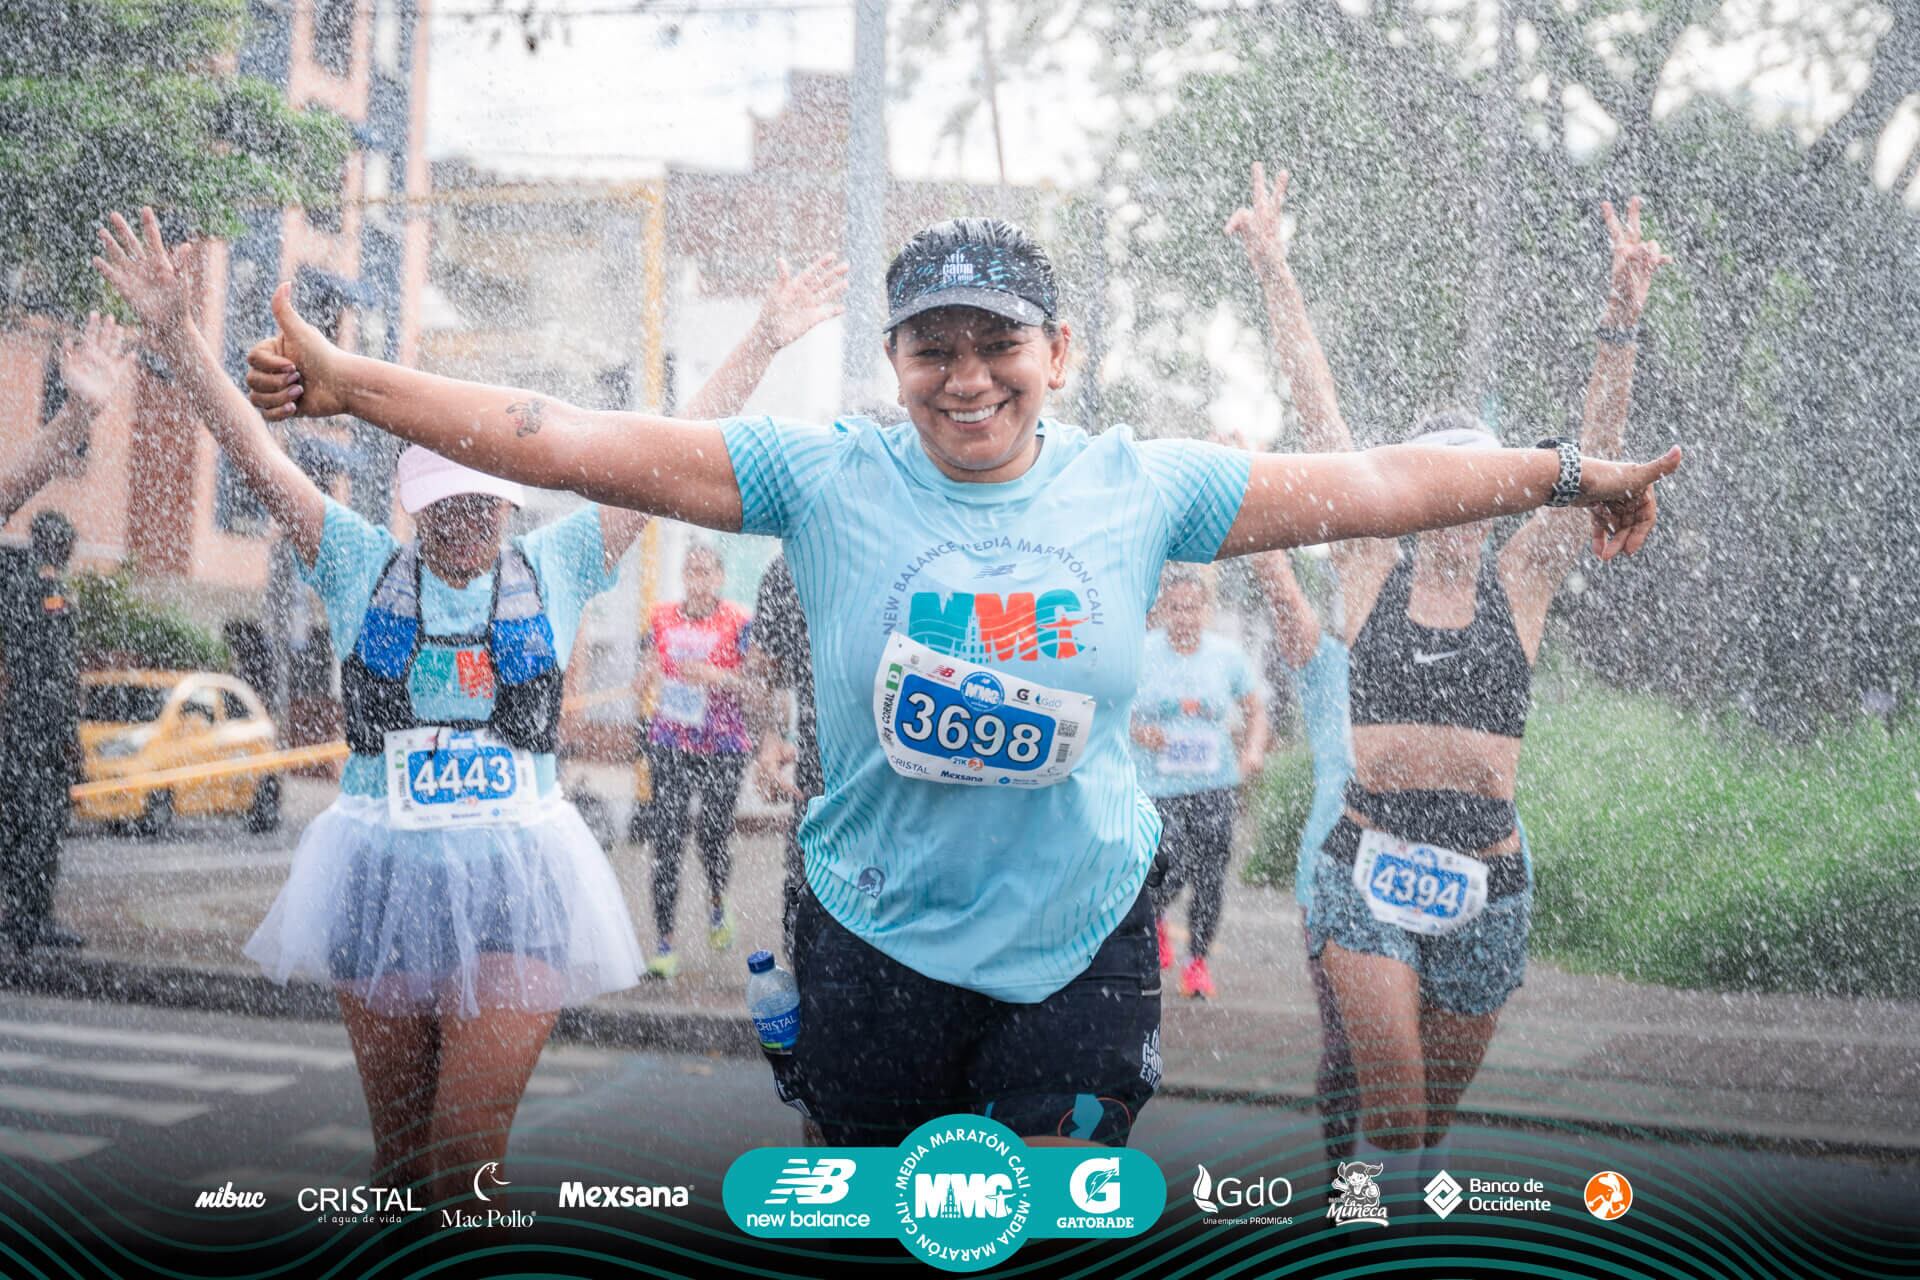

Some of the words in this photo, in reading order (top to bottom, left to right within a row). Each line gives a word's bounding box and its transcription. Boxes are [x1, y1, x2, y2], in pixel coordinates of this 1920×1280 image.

[883, 596, 900, 635] NEW
[893, 541, 961, 593] BALANCE
[1086, 588, 1105, 626] CALI
[882, 692, 896, 724] CORRAL
[902, 691, 1042, 766] 3698
[413, 755, 512, 797] 4443
[890, 755, 928, 775] CRISTAL
[940, 769, 983, 782] Mexsana
[1374, 864, 1460, 912] 4394
[756, 1015, 796, 1034] CRISTAL
